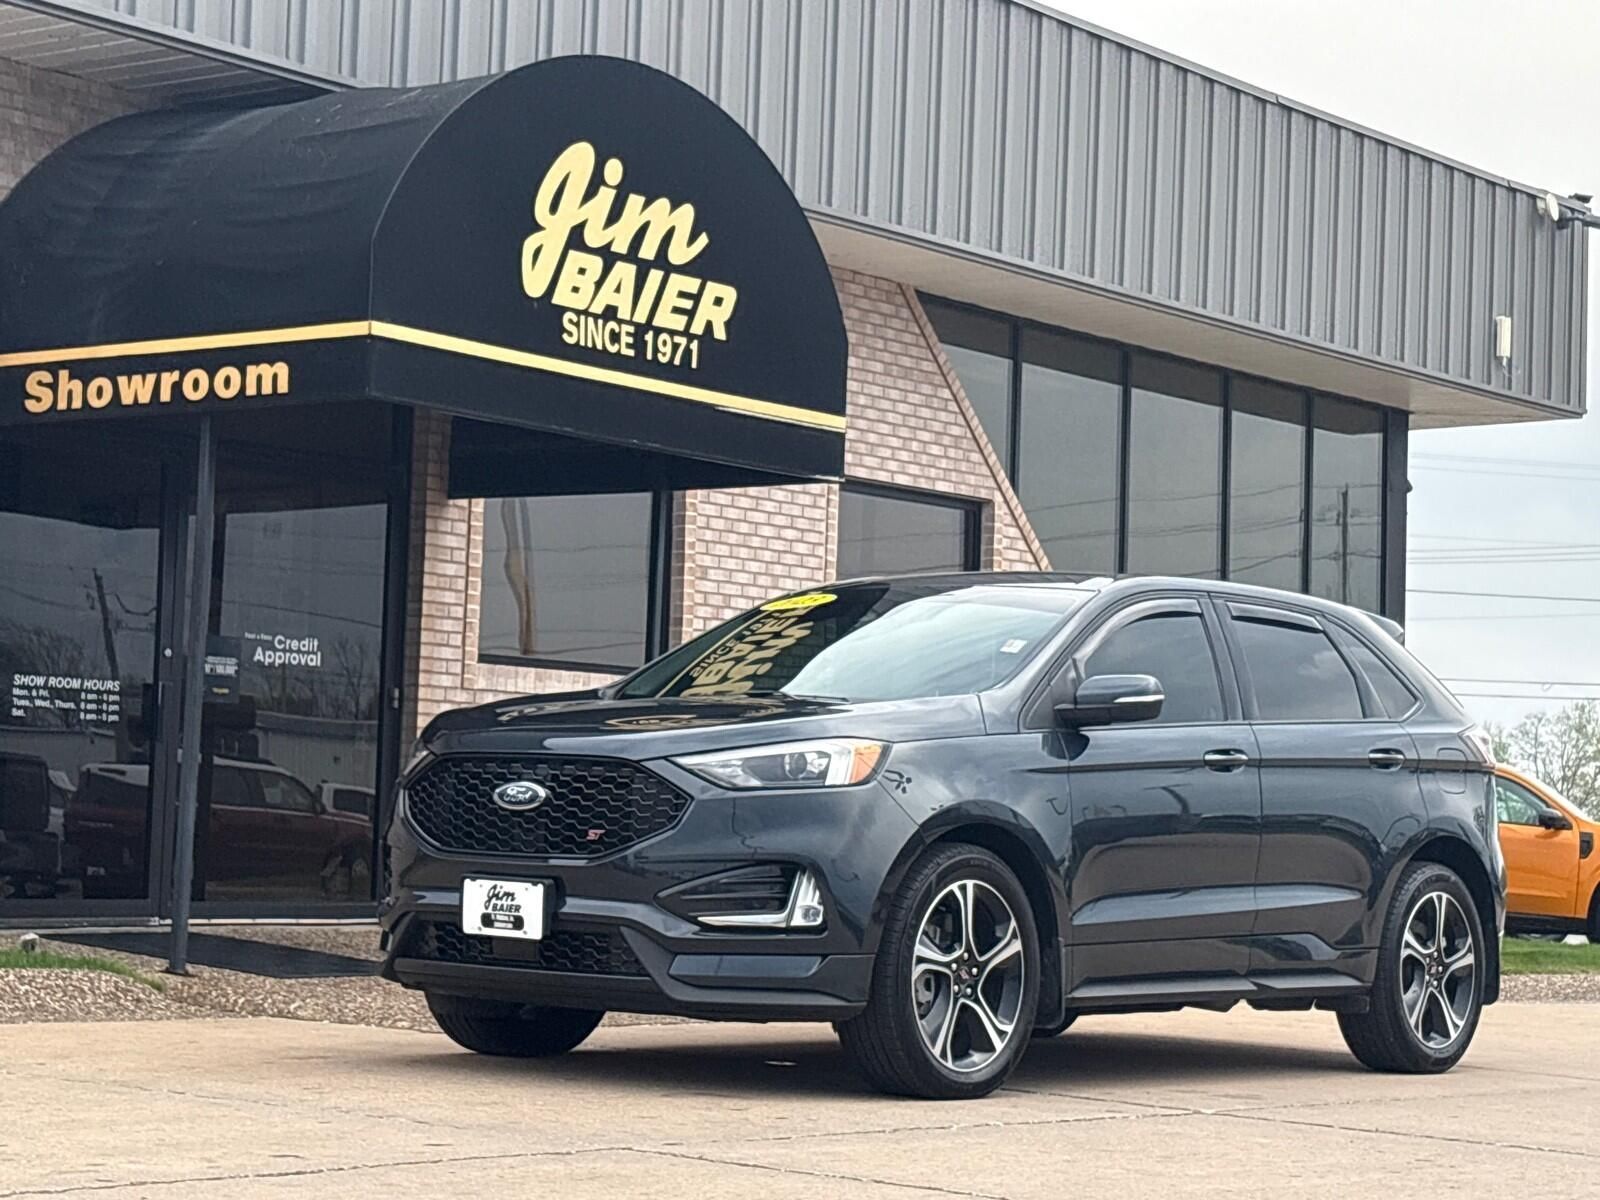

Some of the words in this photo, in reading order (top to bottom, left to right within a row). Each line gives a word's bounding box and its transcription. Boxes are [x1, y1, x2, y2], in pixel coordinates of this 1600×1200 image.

[522, 141, 710, 299] Jim
[551, 249, 738, 341] BAIER
[562, 311, 635, 357] SINCE
[644, 329, 699, 369] 1971
[23, 361, 289, 414] Showroom
[253, 646, 321, 667] Approval
[274, 635, 319, 652] Credit
[13, 673, 47, 687] SHOW
[48, 676, 81, 690] ROOM
[83, 679, 121, 692] HOURS
[484, 884, 516, 911] Jim
[491, 903, 522, 913] BAIER
